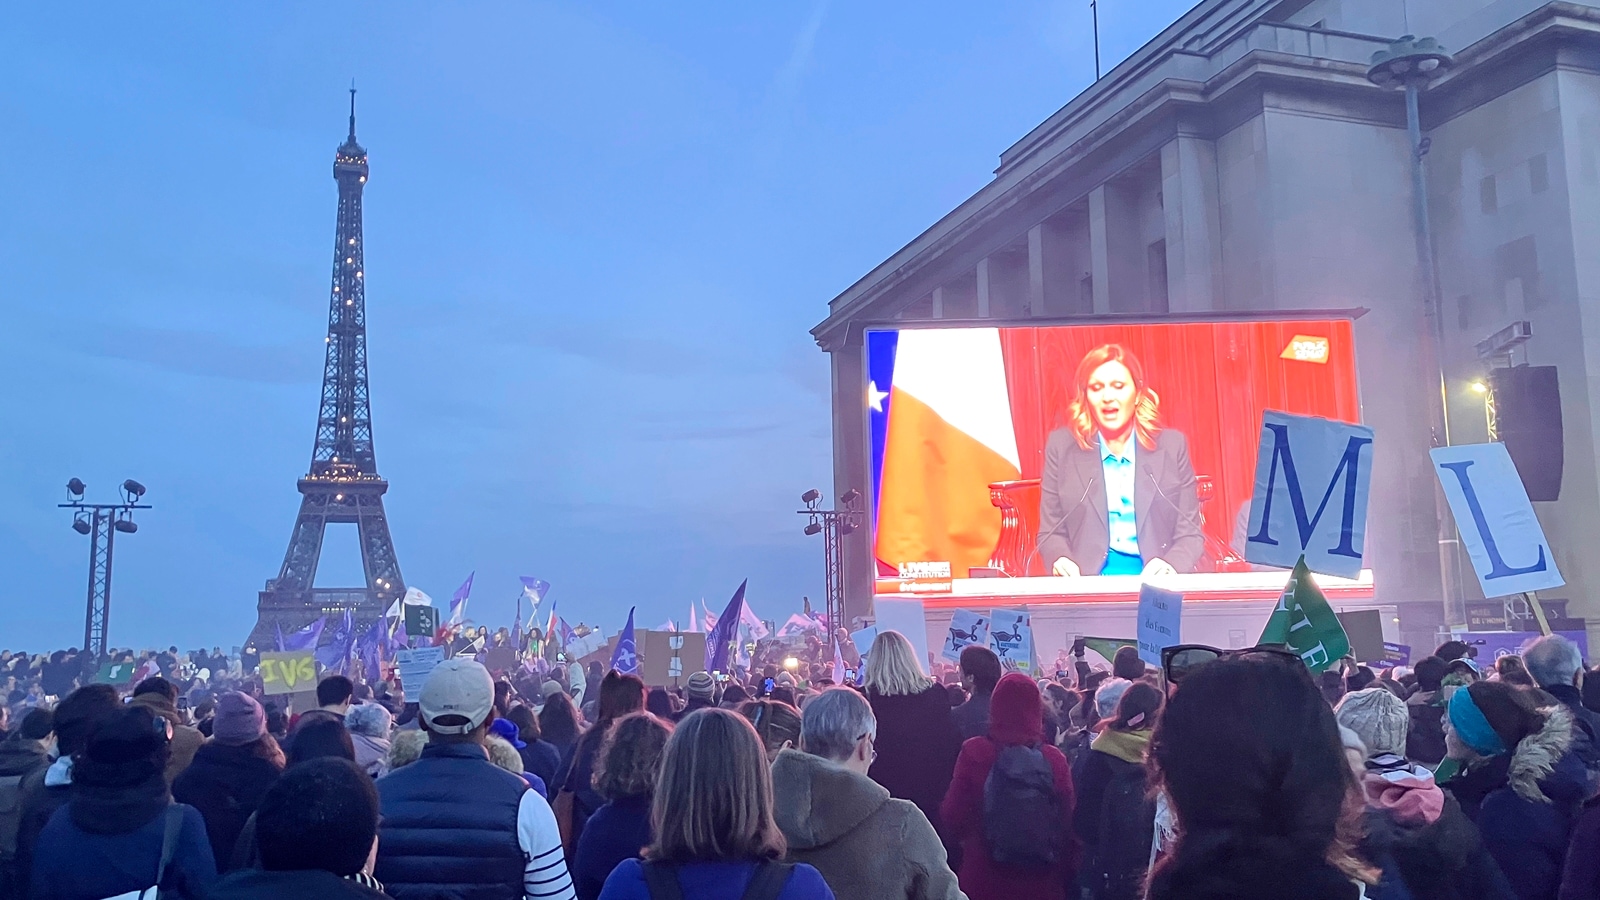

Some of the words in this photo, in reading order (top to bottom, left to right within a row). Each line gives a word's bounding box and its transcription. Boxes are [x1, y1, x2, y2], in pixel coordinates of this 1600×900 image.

[1248, 422, 1373, 559] M
[1439, 460, 1547, 580] L
[260, 656, 315, 689] IVG
